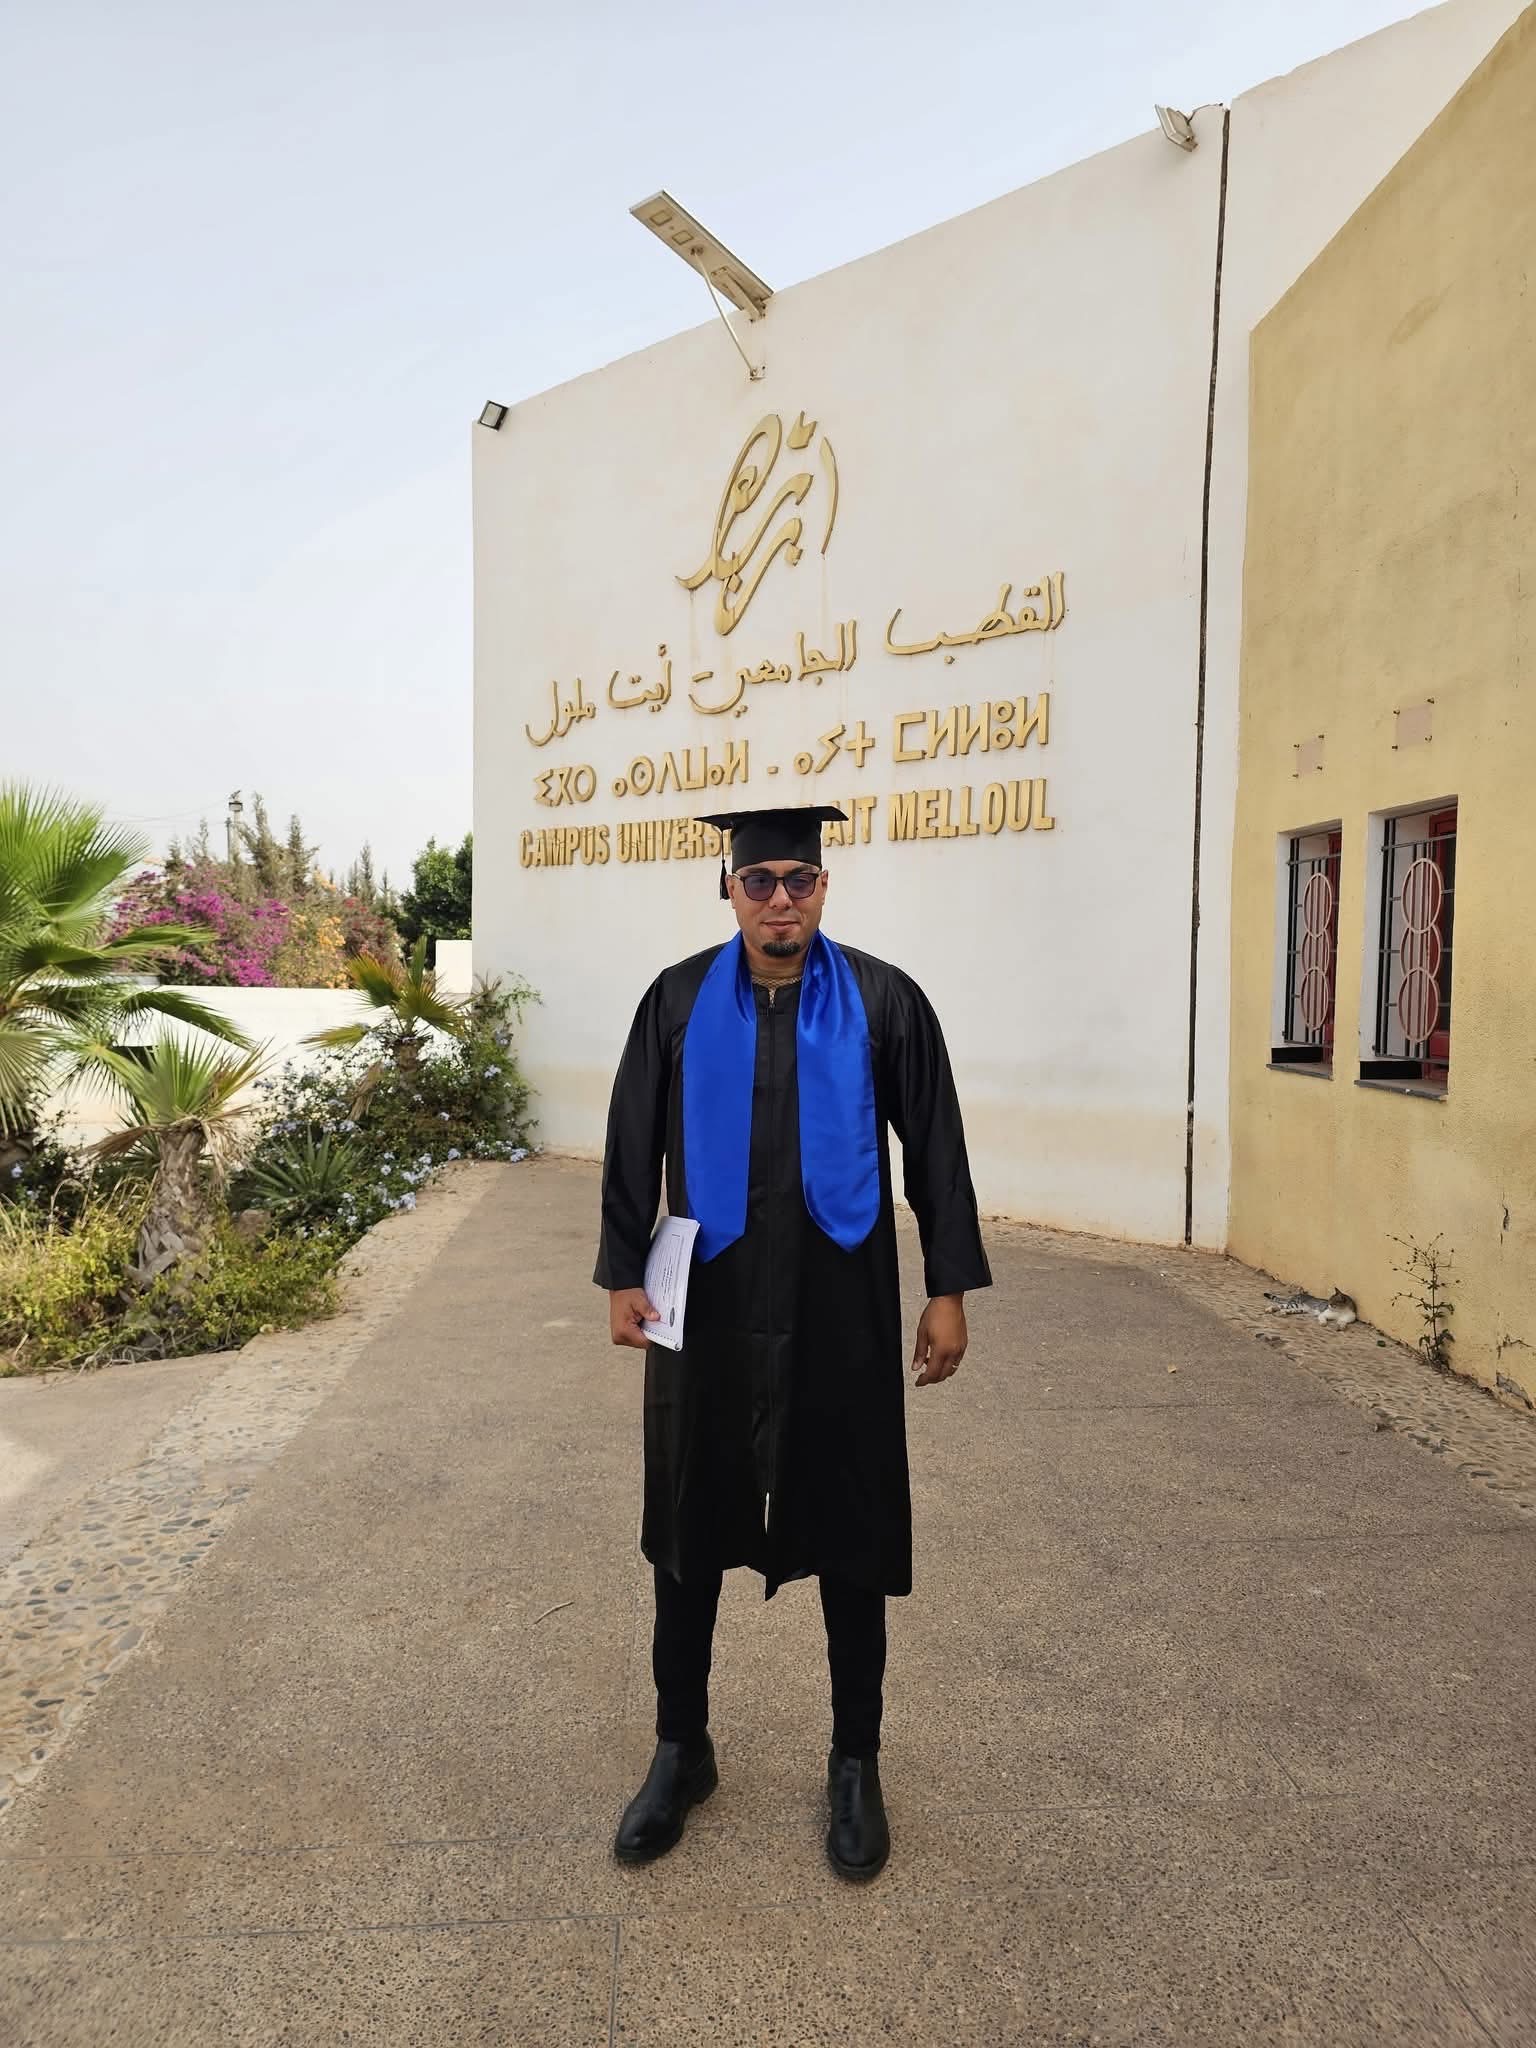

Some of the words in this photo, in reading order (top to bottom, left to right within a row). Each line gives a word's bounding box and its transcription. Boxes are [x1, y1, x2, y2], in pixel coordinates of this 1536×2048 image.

[885, 571, 1065, 665] القطب
[525, 677, 597, 747] ملول
[519, 824, 611, 869] CAMPUS
[616, 817, 732, 864] UNIVERSI
[888, 777, 1056, 842] MELLOUL
